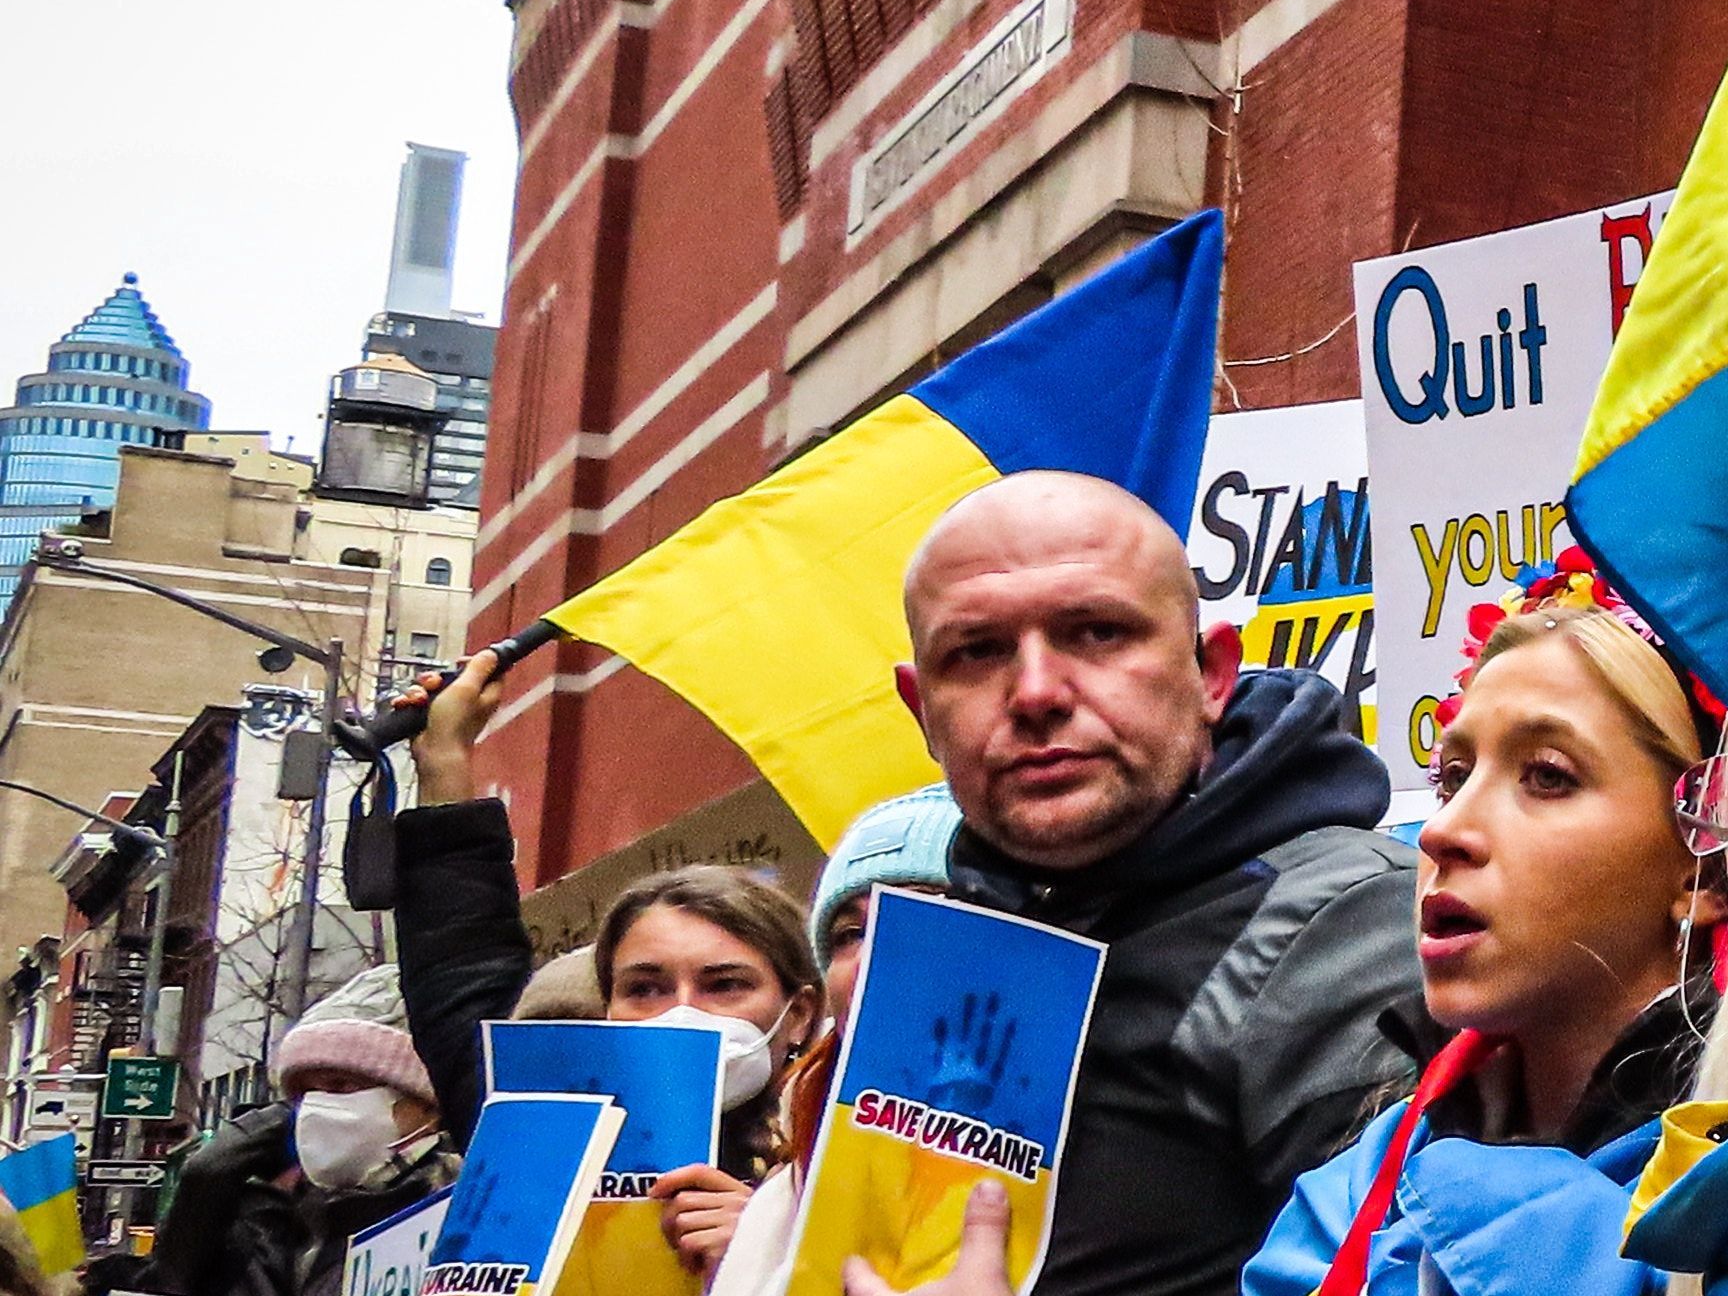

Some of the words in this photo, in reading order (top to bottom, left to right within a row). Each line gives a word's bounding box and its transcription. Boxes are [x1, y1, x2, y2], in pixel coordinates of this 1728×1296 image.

[1372, 265, 1547, 425] Quit
[1410, 502, 1570, 639] your
[855, 1093, 924, 1138] SAVE
[922, 1114, 1042, 1180] UKRAINE
